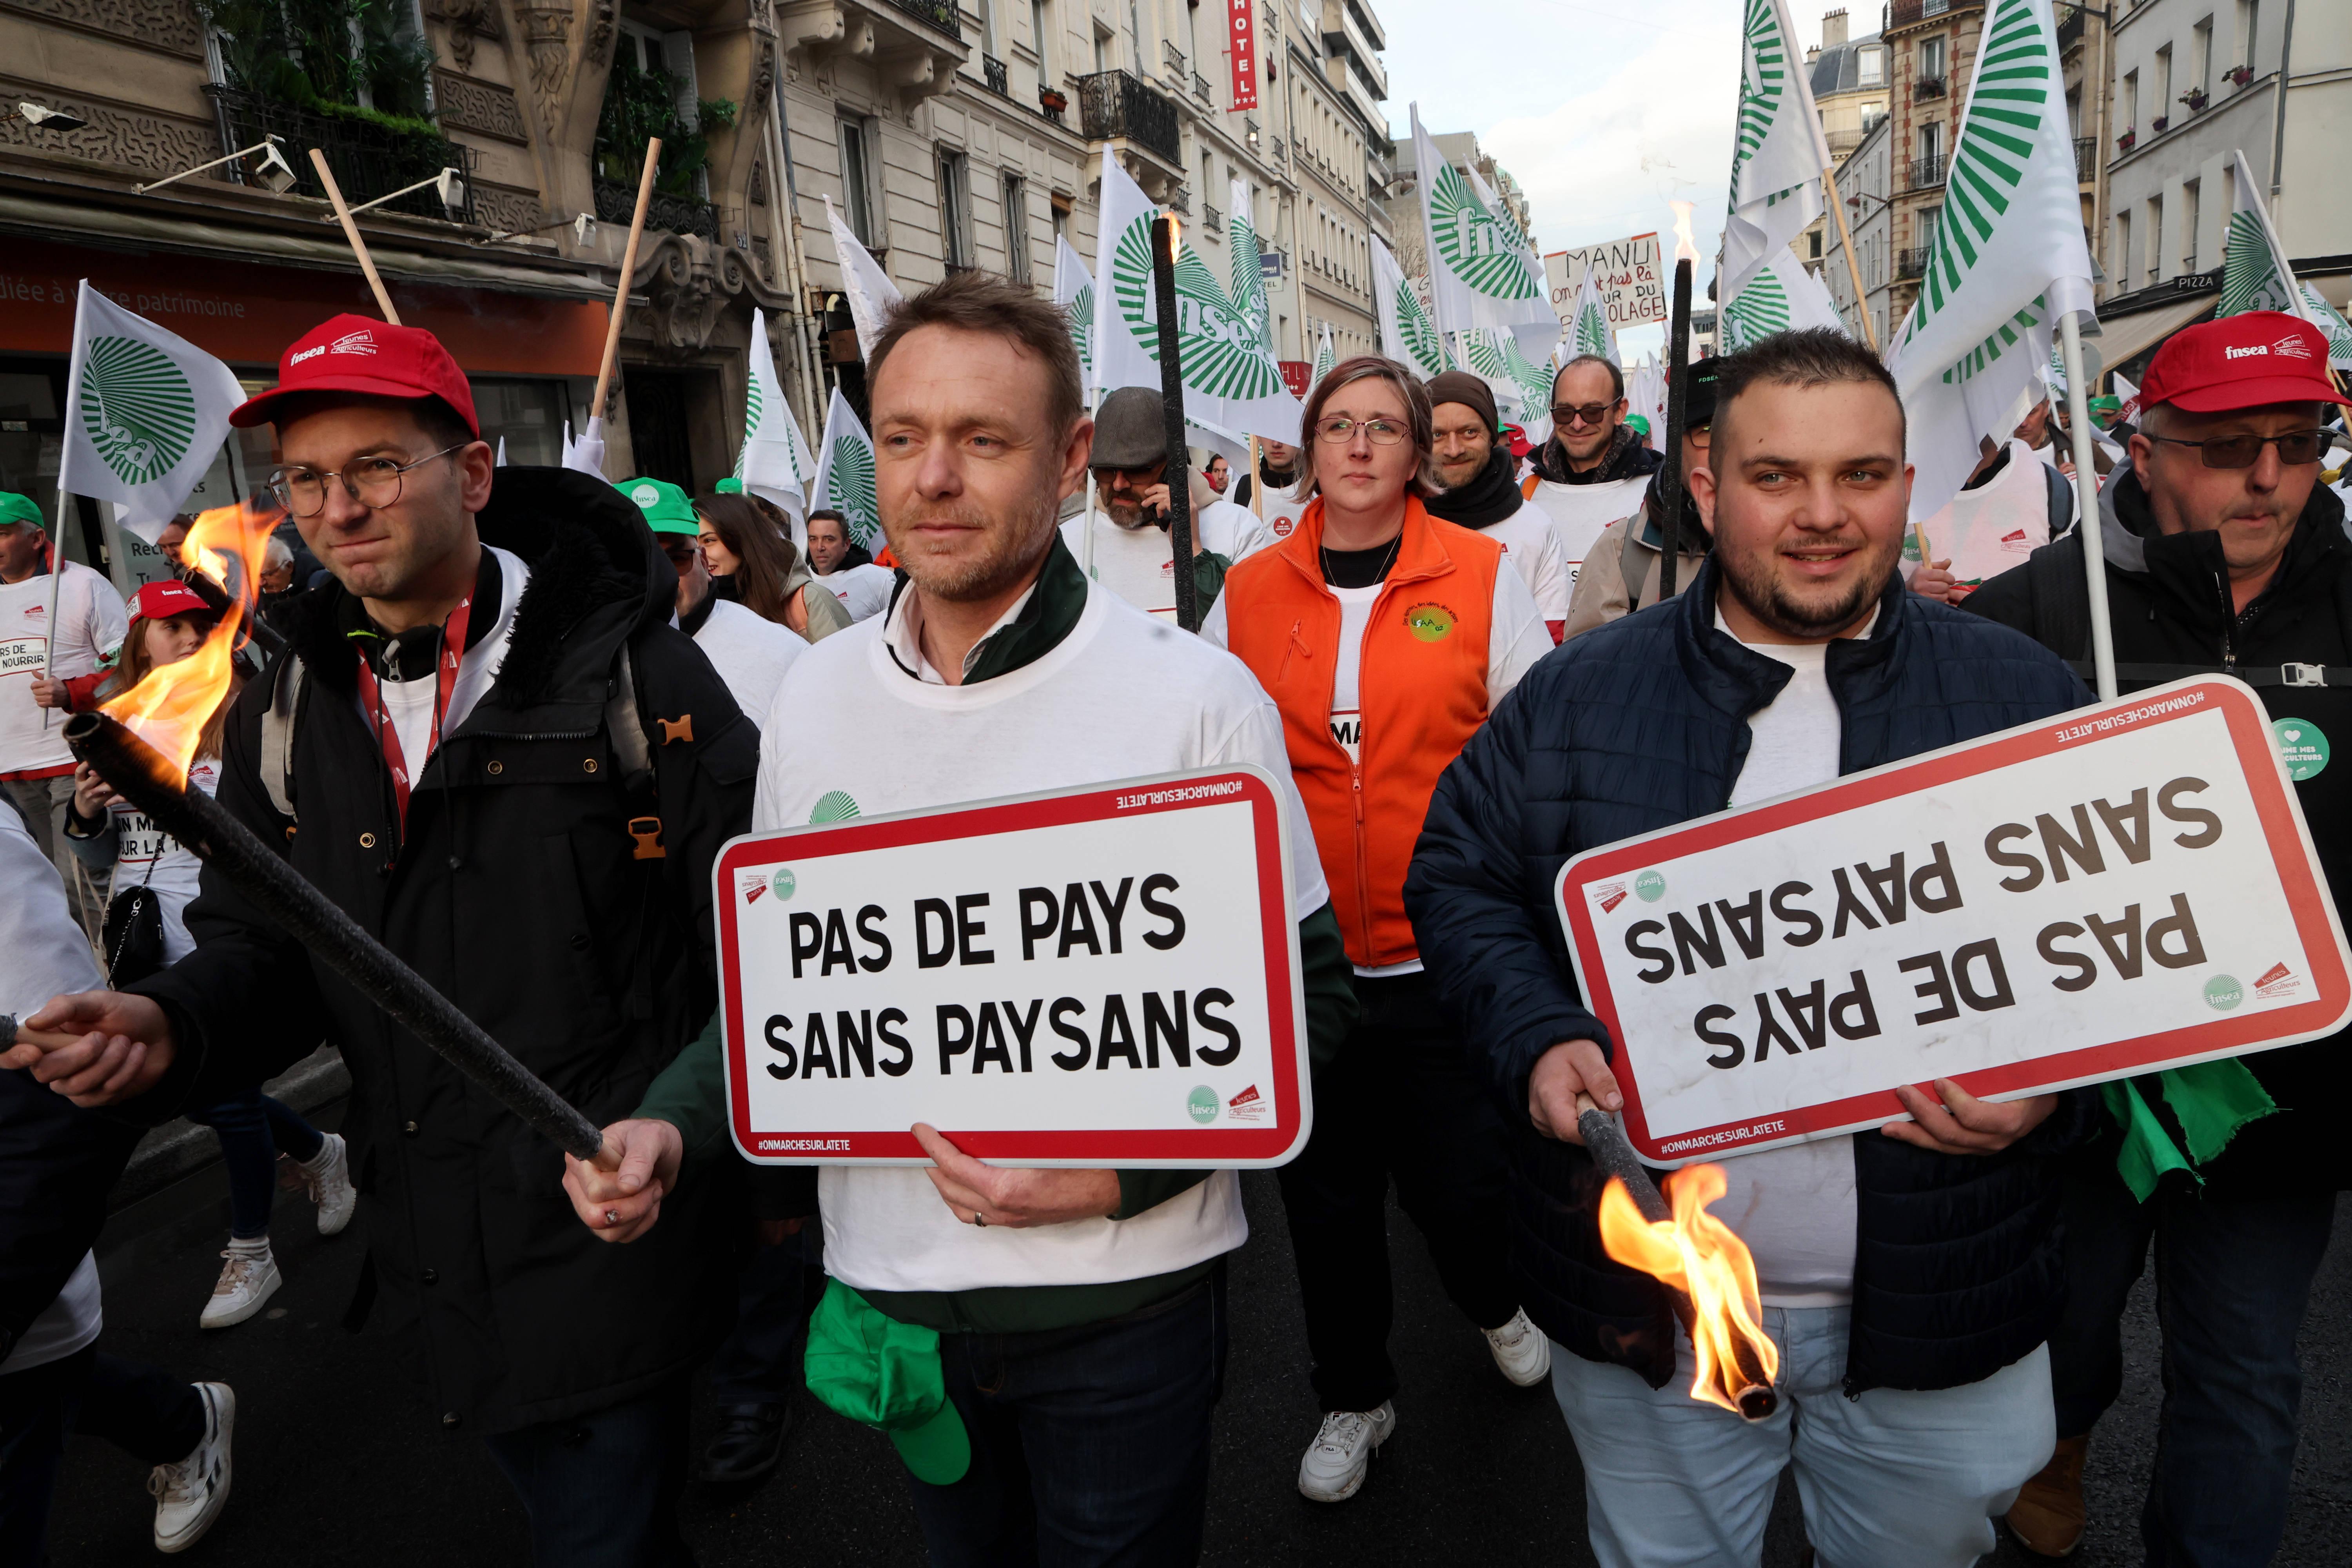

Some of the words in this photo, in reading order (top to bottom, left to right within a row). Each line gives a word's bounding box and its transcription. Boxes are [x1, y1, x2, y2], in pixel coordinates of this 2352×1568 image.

[1234, 0, 1250, 93] HOTEL
[1567, 240, 1649, 278] MANU
[1552, 287, 1572, 304] on
[1607, 271, 1632, 291] pas
[2178, 276, 2214, 288] PIZZA
[52, 281, 65, 303] à
[137, 292, 246, 318] patrimoine
[1602, 290, 1621, 304] UR
[1635, 284, 1655, 297] DU
[341, 334, 368, 345] Jeunes
[291, 345, 325, 367] fnsea
[335, 345, 376, 354] Agriculteurs
[2225, 345, 2268, 359] fnsea
[2278, 348, 2311, 358] Agriculteurs
[13, 645, 26, 654] DE
[3, 655, 45, 669] NOURRIR
[2055, 691, 2205, 744] #ONMARCHESURLATETE
[1116, 780, 1243, 809] #ONMARCHESURLATETE
[1984, 777, 2222, 893] SANS
[776, 877, 792, 885] fnsea
[1638, 877, 1661, 887] fnsea
[1625, 840, 1964, 984] PAYSANS
[789, 904, 893, 978] PAS
[914, 892, 995, 969] DE
[1018, 873, 1186, 961] PAYS
[2036, 892, 2207, 992] PAS
[1898, 937, 2015, 1025] DE
[2261, 969, 2286, 984] Jeunes
[2261, 980, 2300, 995] Agriculteurs
[2209, 992, 2239, 1004] fnsea
[1694, 969, 1881, 1069] PAYS
[764, 1007, 913, 1080] SANS
[936, 987, 1241, 1075] PAYSANS
[1236, 1092, 1257, 1105] Jeunes
[1191, 1103, 1215, 1114] fnsea
[1233, 1107, 1266, 1115] Agriculteurs
[758, 1139, 851, 1151] #ONMARCHESURLATETE
[1661, 1119, 1786, 1154] #ONMARCHESURLATETE
